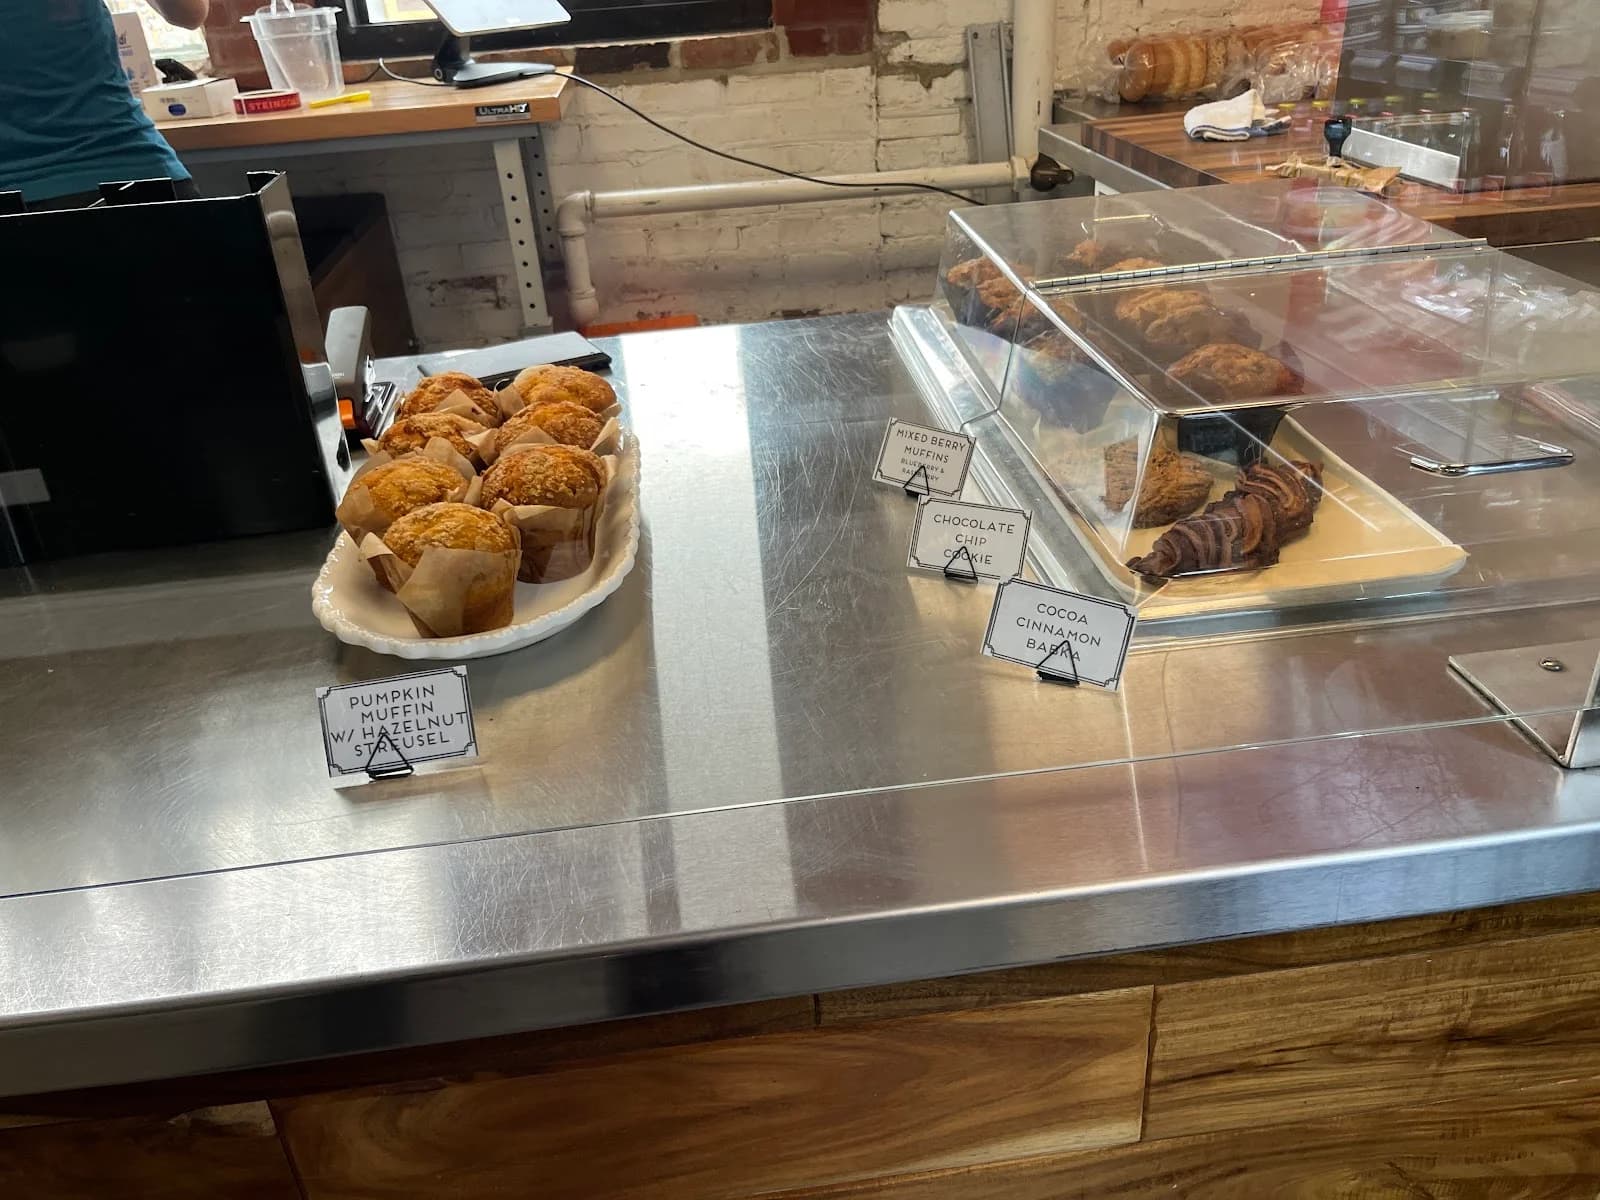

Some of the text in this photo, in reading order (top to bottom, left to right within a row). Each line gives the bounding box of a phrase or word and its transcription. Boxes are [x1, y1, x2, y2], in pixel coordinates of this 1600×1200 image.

[896, 429, 966, 452] MIXED BERRY
[903, 445, 949, 464] MUFFINS
[901, 467, 940, 481] RASBERRY
[933, 514, 1015, 534] CHOCOLATE
[955, 533, 987, 546] CHIP
[943, 548, 993, 565] COOKIE
[1037, 603, 1088, 625] COCOA
[1016, 616, 1101, 647] CINNAMON
[1026, 638, 1081, 662] BABKA
[349, 684, 435, 709] PUMPKIN
[361, 701, 434, 723] MUFFIN
[331, 711, 468, 743] W/ HAZELNUT
[354, 731, 449, 757] STREUSEL
